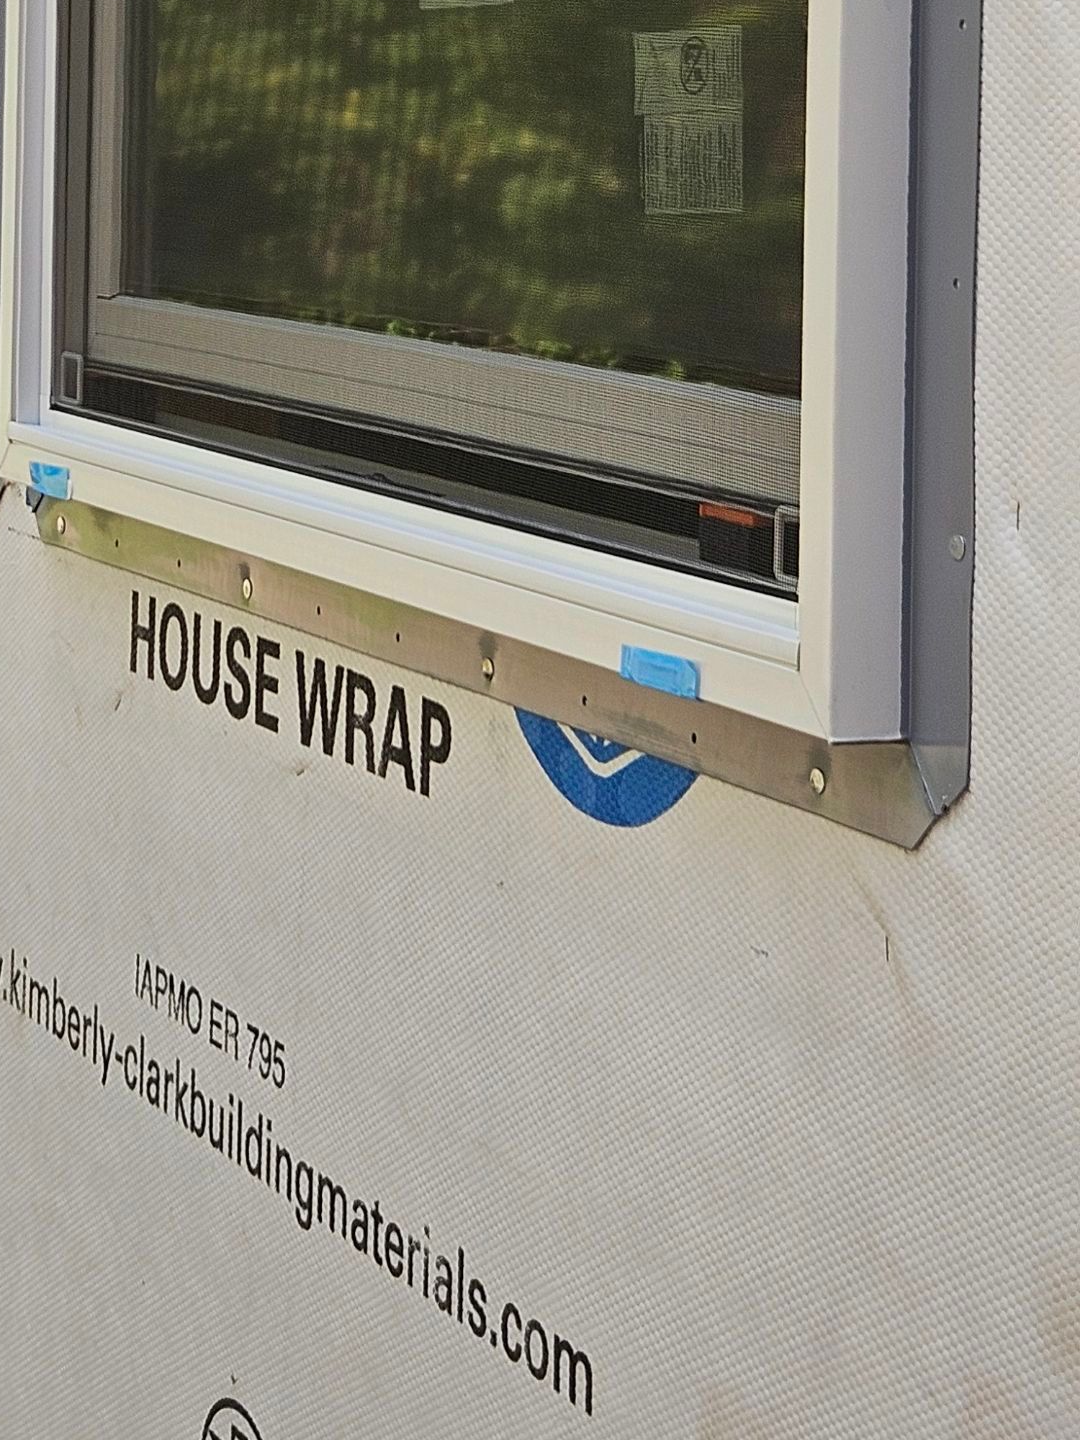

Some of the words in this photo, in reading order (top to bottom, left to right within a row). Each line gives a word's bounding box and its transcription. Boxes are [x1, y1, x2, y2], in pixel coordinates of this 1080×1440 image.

[130, 590, 282, 735] HOUSE
[295, 649, 453, 798] WRAP
[134, 952, 203, 1035] IAPMO
[208, 998, 240, 1062] ER
[245, 1023, 287, 1089] 795
